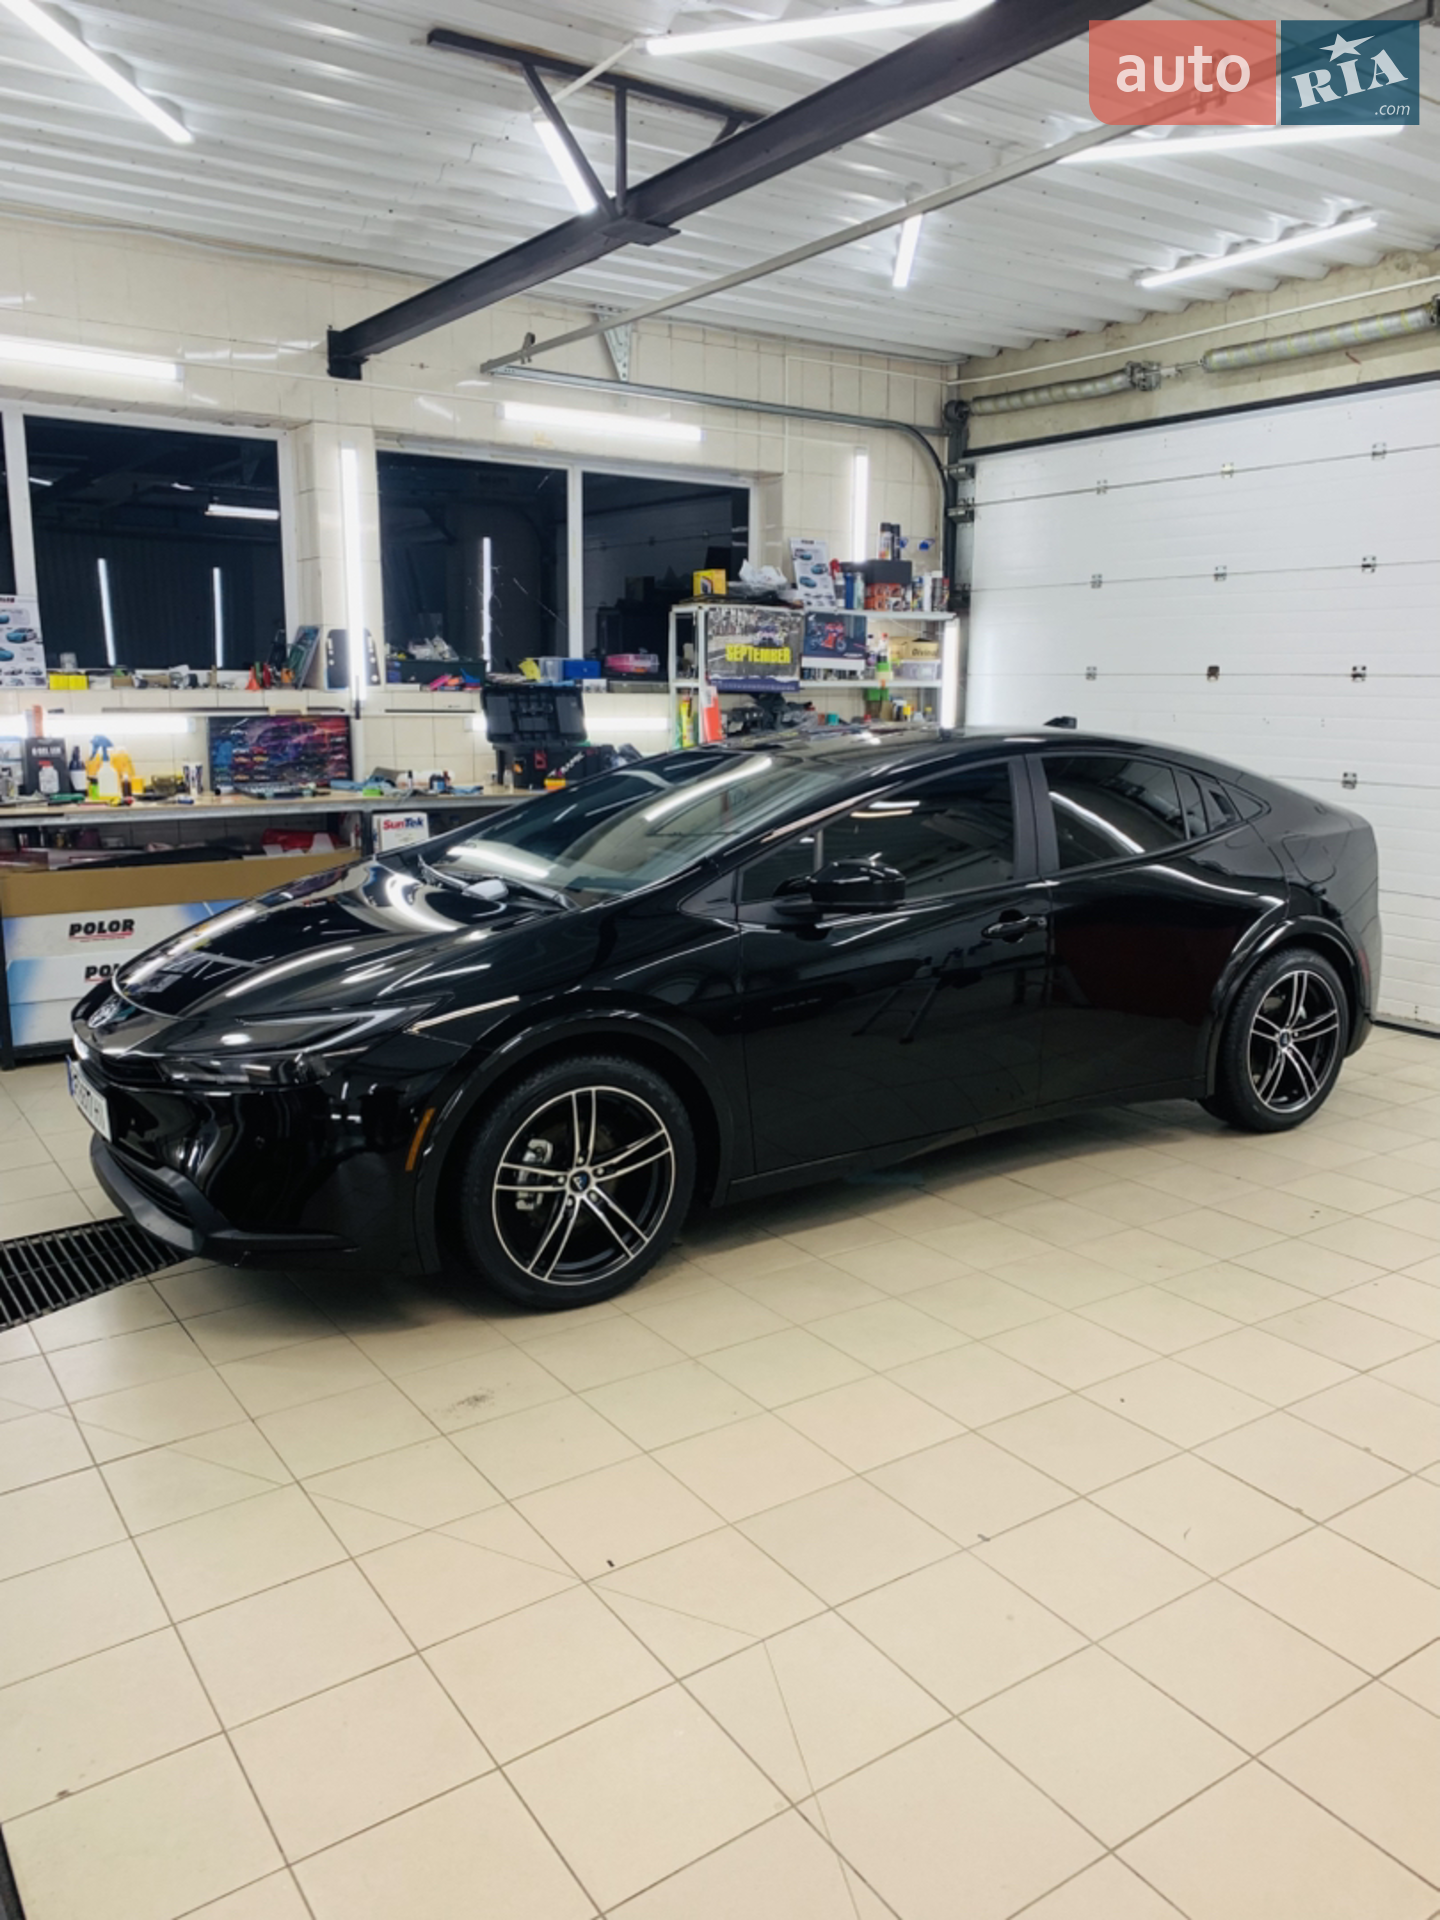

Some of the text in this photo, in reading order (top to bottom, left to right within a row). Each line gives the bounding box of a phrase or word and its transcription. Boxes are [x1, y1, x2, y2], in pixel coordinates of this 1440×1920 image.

[726, 644, 791, 664] SEPTEMBER
[383, 817, 424, 830] SunTek
[69, 919, 135, 936] POLOR
